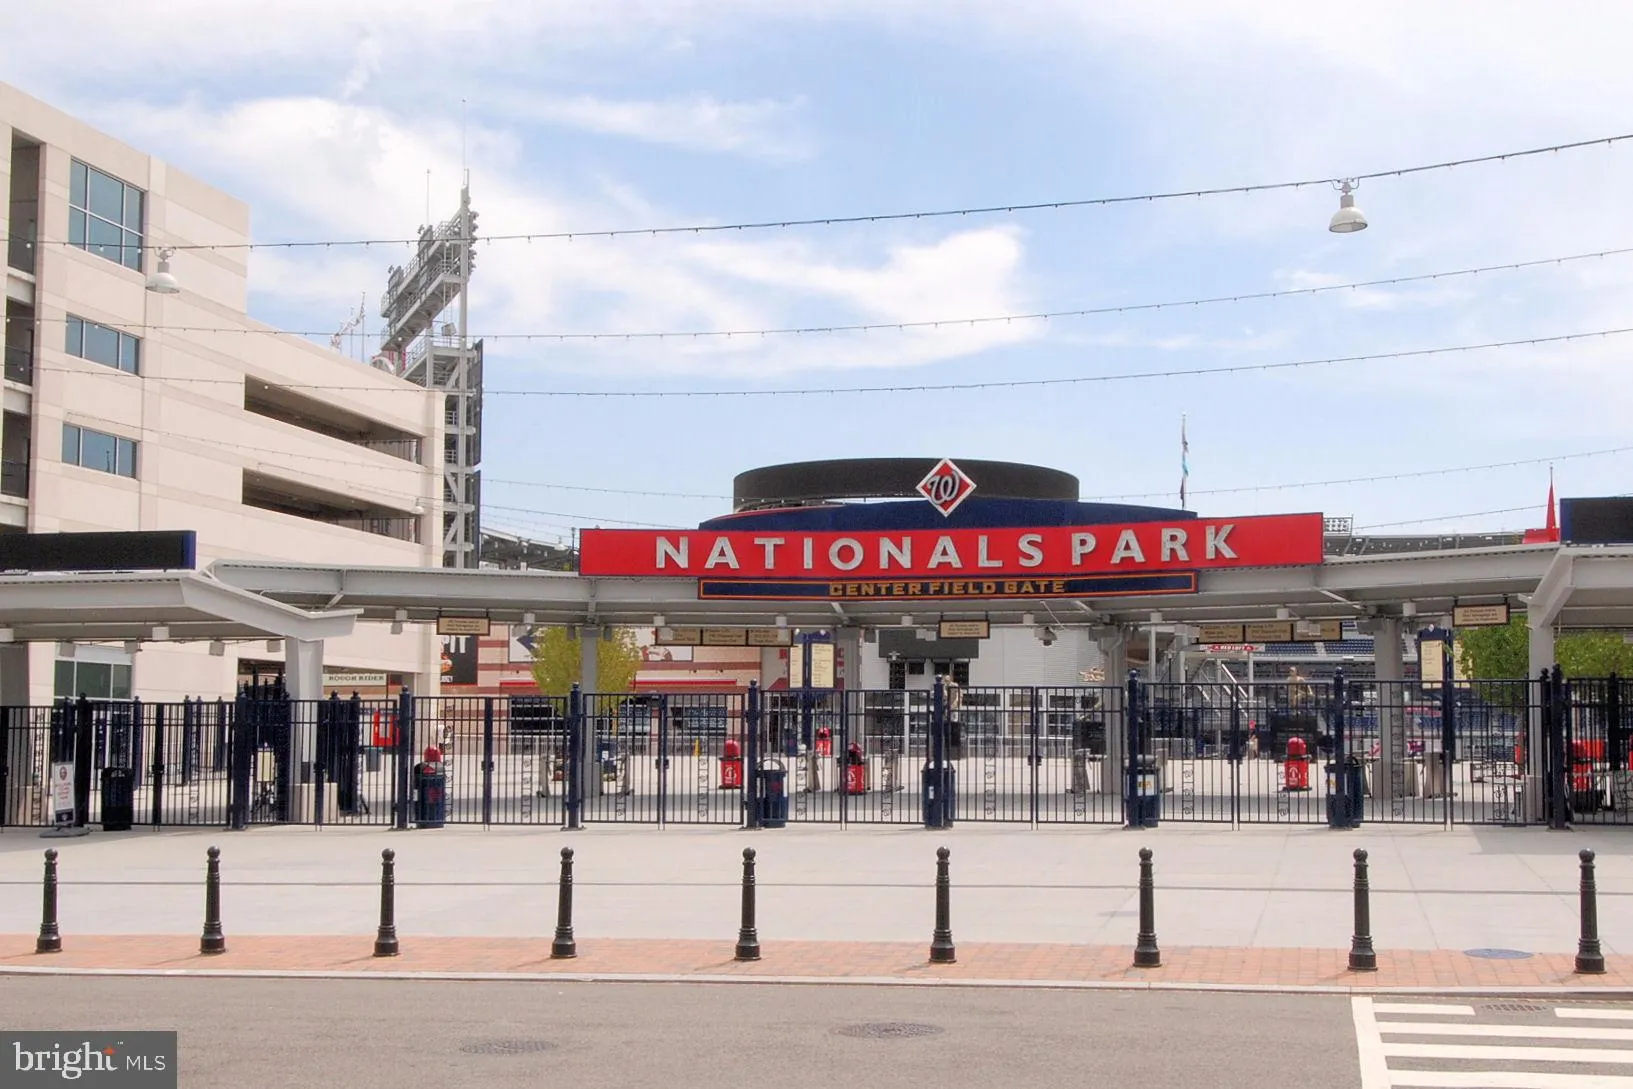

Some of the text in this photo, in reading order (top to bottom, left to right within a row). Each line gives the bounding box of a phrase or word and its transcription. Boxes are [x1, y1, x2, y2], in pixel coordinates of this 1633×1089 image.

[655, 524, 1238, 570] NATIONALS PARK
[829, 579, 1066, 596] CENTER FIELD GATE
